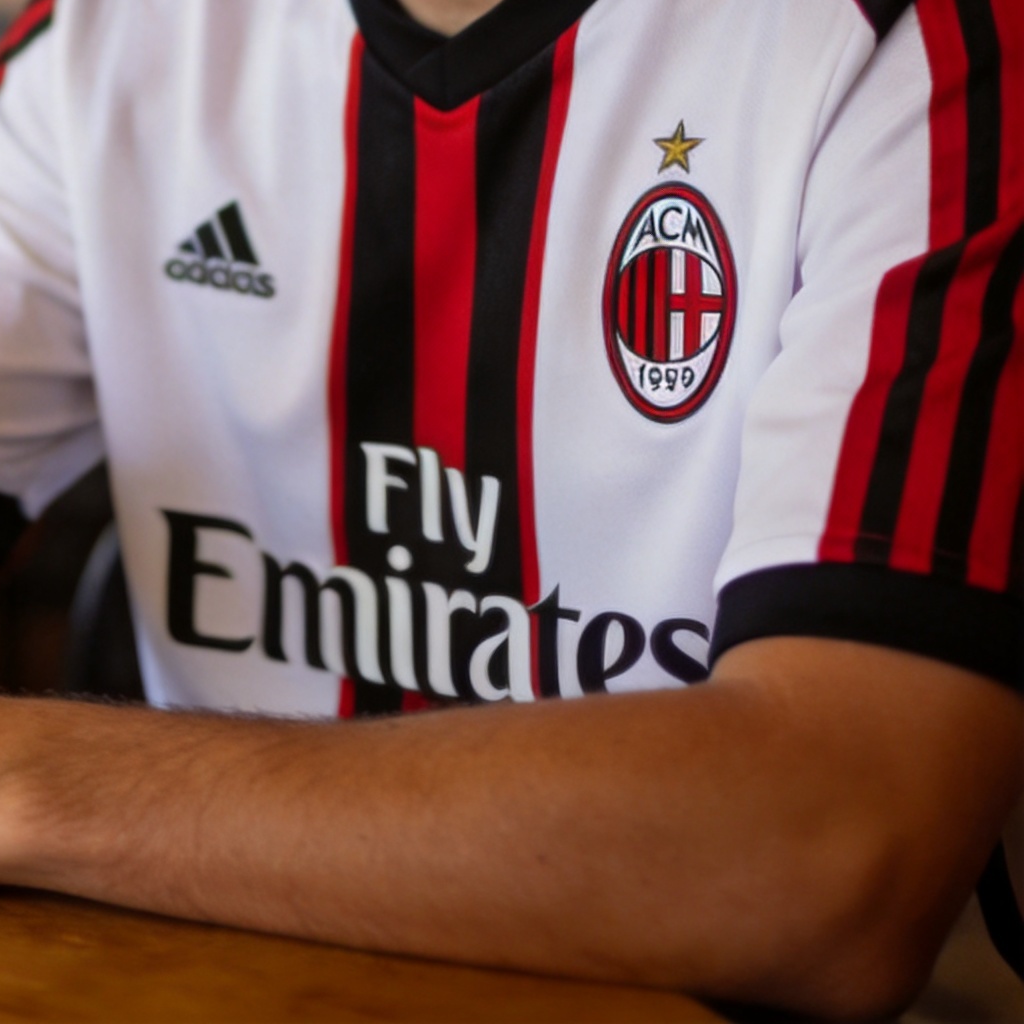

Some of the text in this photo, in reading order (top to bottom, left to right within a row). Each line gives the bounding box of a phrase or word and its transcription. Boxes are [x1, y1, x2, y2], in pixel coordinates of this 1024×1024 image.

[630, 206, 709, 255] ACM
[360, 442, 500, 573] Fly
[159, 508, 711, 702] Emirates
